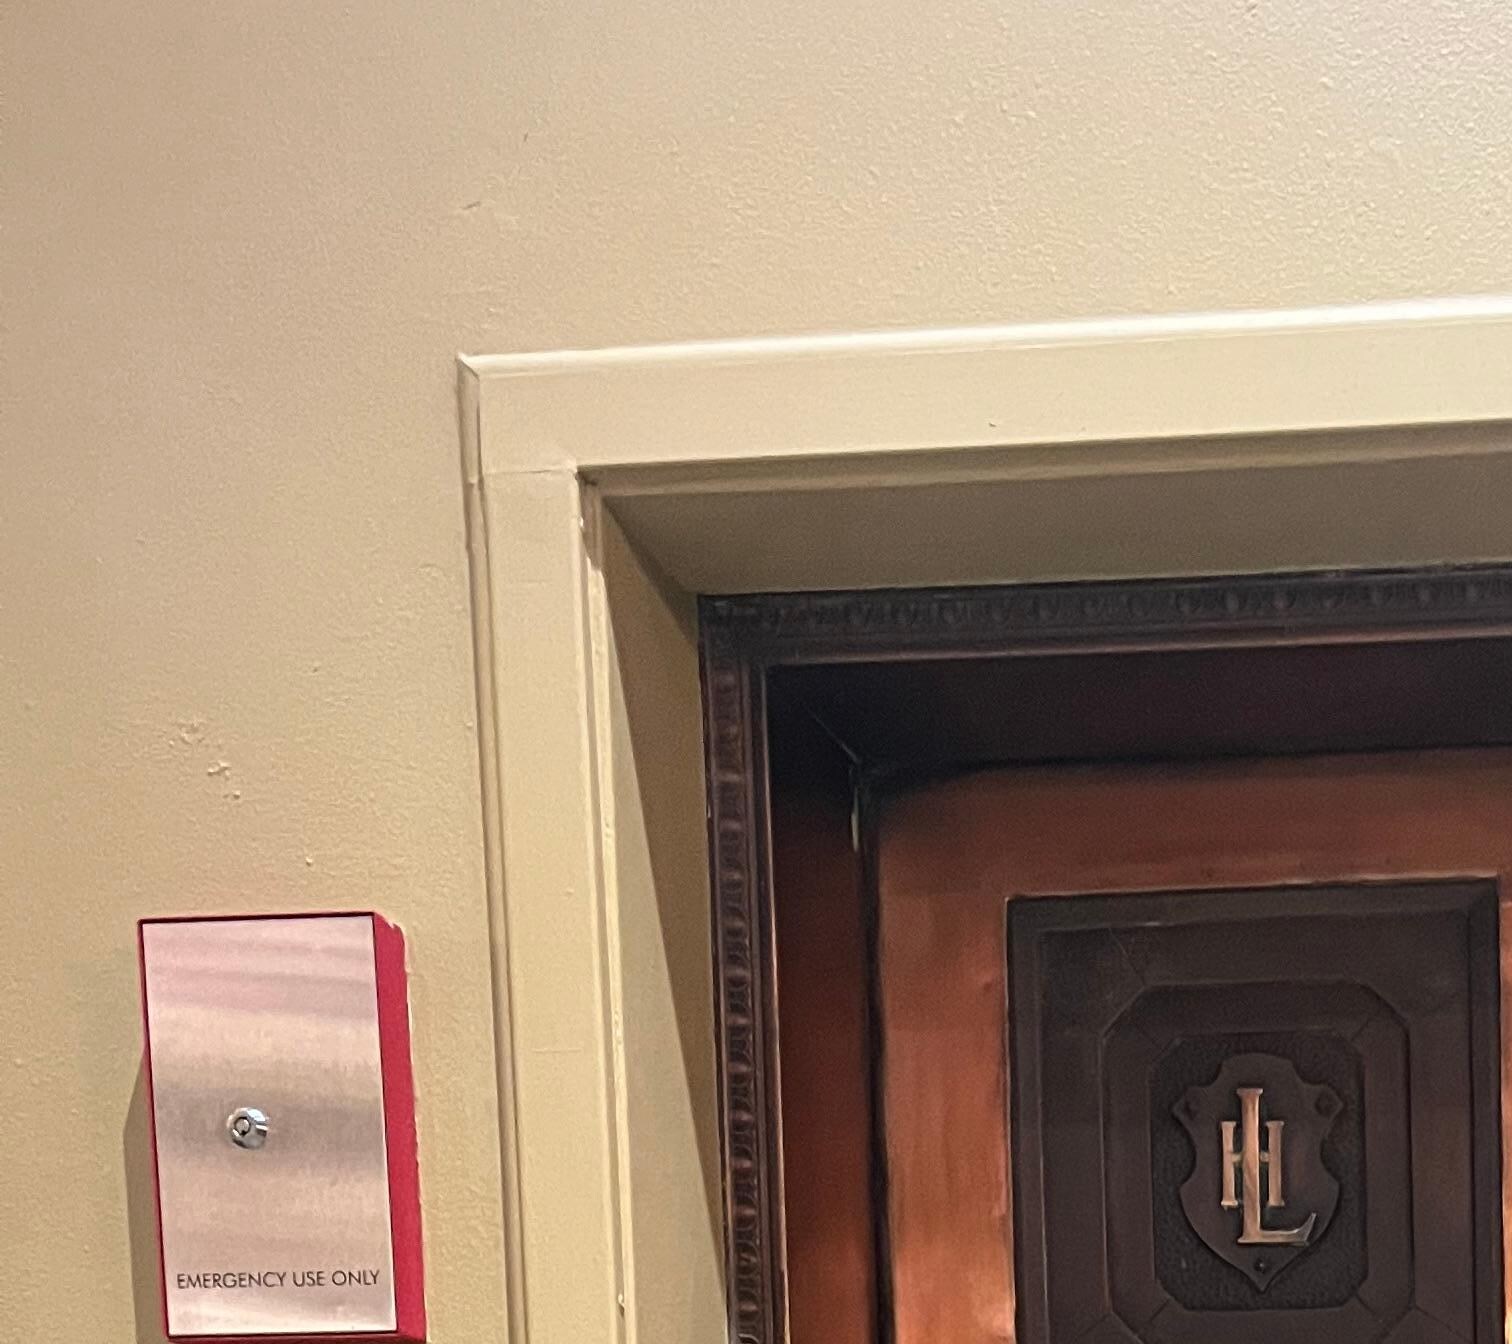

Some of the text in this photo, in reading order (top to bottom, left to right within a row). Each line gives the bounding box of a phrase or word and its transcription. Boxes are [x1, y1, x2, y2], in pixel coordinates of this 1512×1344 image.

[176, 1269, 381, 1290] EMERGENCY USE ONLY
